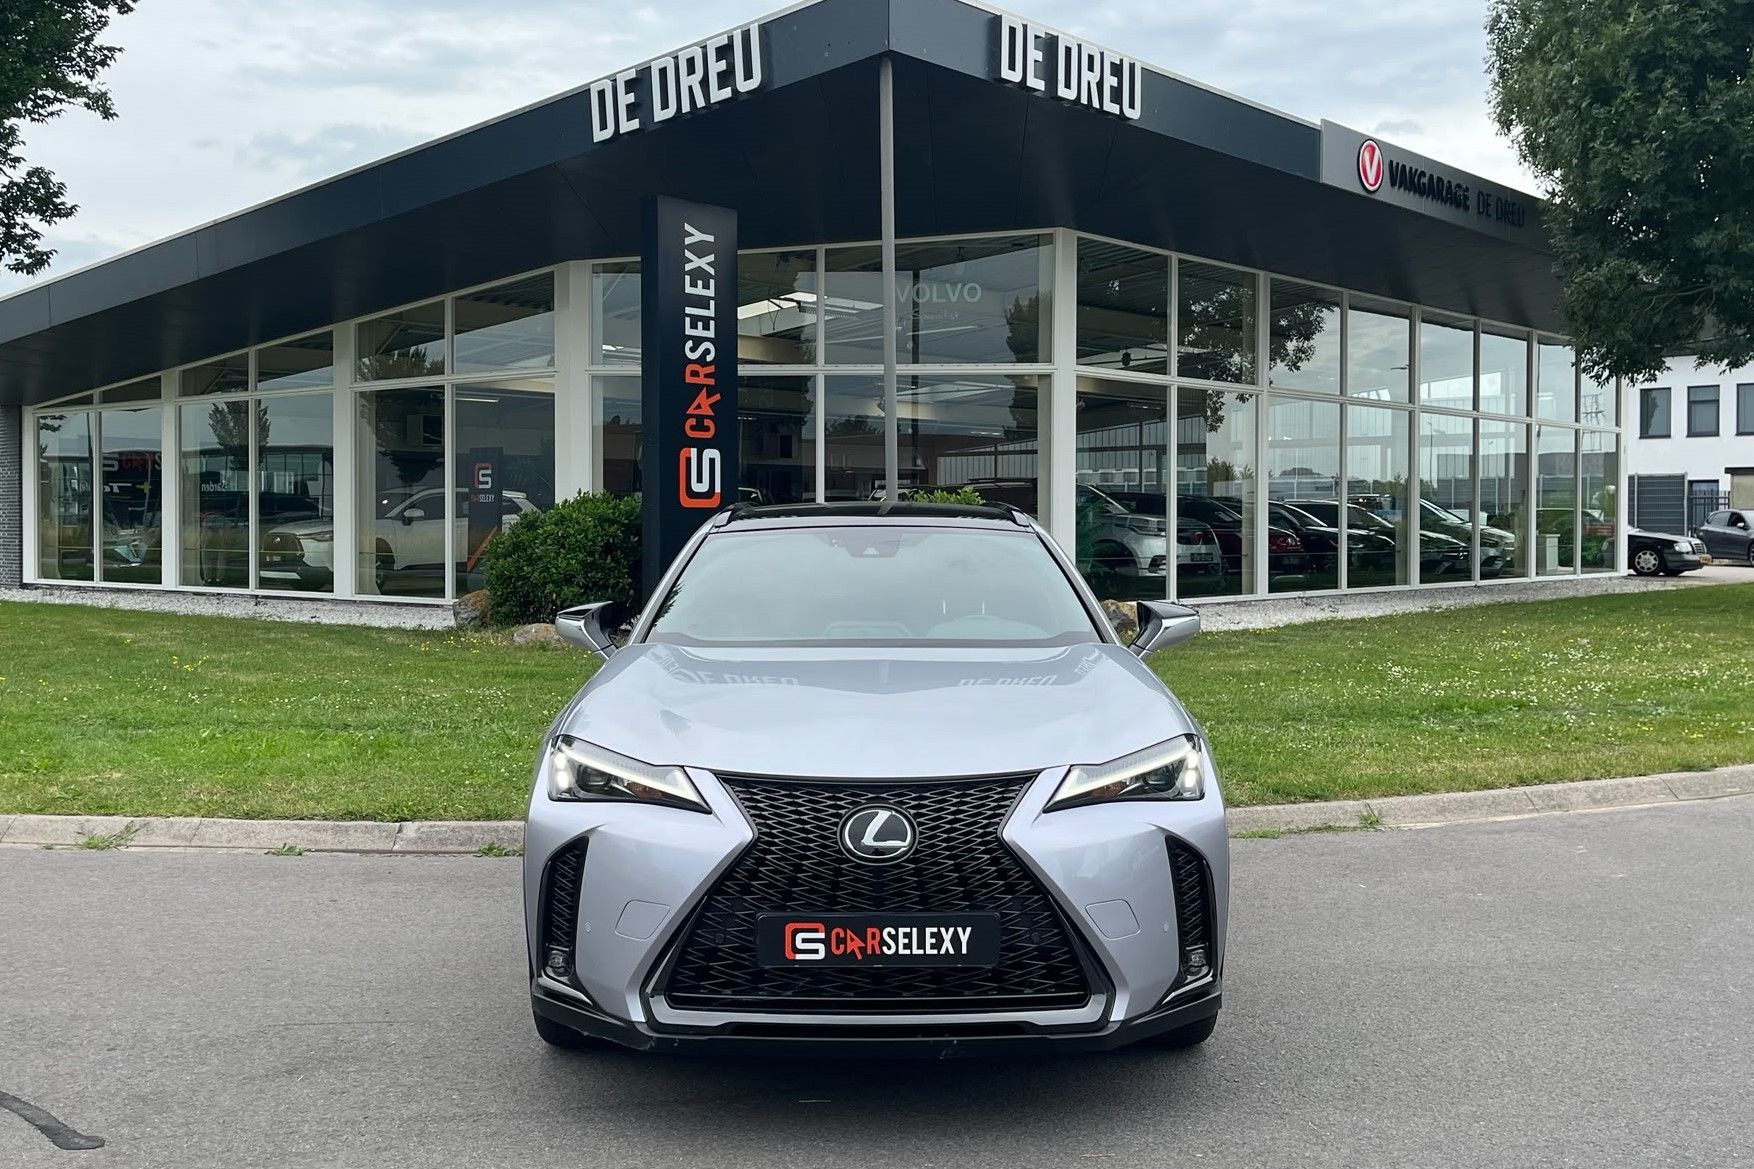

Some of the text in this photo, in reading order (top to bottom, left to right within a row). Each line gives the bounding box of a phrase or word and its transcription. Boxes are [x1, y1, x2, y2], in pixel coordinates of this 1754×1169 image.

[590, 23, 762, 143] DE DREU
[1000, 14, 1142, 120] DE DREU
[1388, 159, 1526, 228] VAKGARAGE DE DREU
[684, 222, 721, 438] CARSELEXY
[895, 282, 982, 303] VOLVO
[830, 926, 972, 960] CARSELEXY
